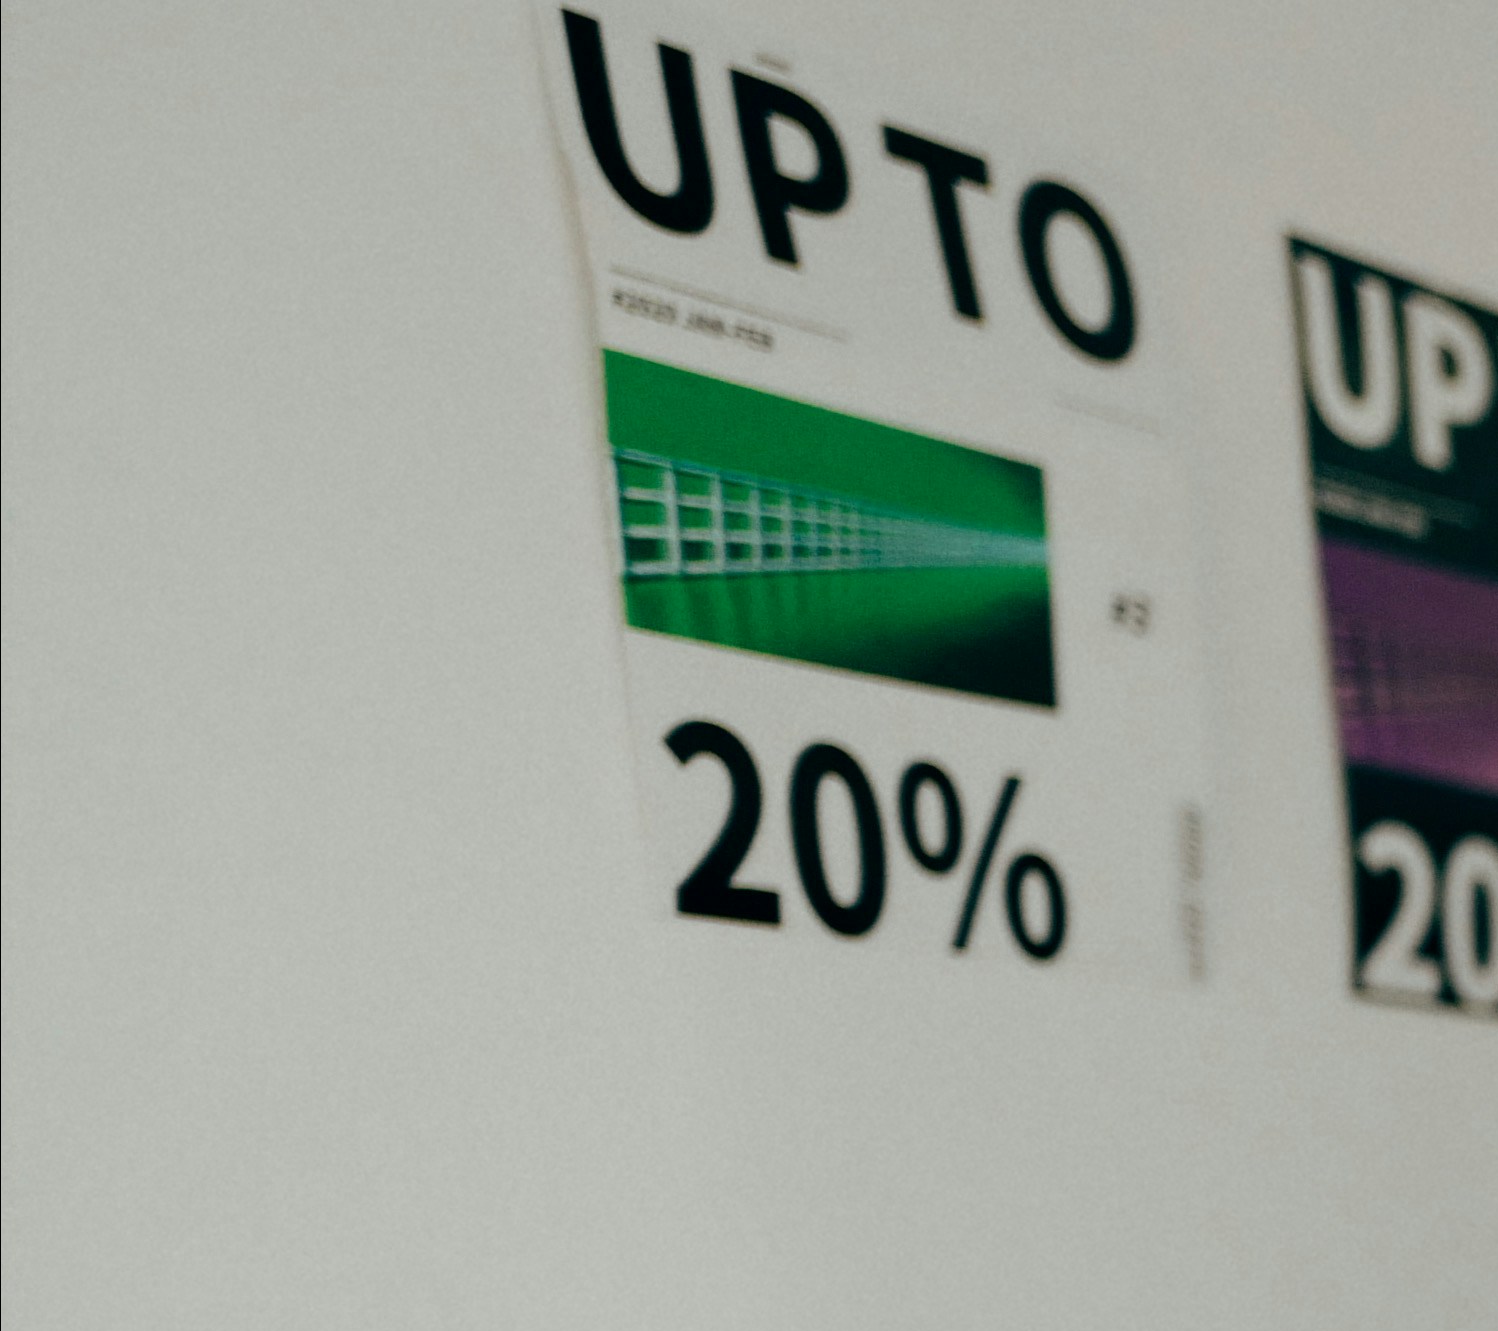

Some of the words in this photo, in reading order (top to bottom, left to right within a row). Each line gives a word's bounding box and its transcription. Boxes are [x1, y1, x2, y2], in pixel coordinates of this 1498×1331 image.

[562, 8, 852, 270] UP
[880, 122, 1138, 366] TO
[1298, 252, 1496, 472] UP
[662, 720, 1068, 962] 20%
